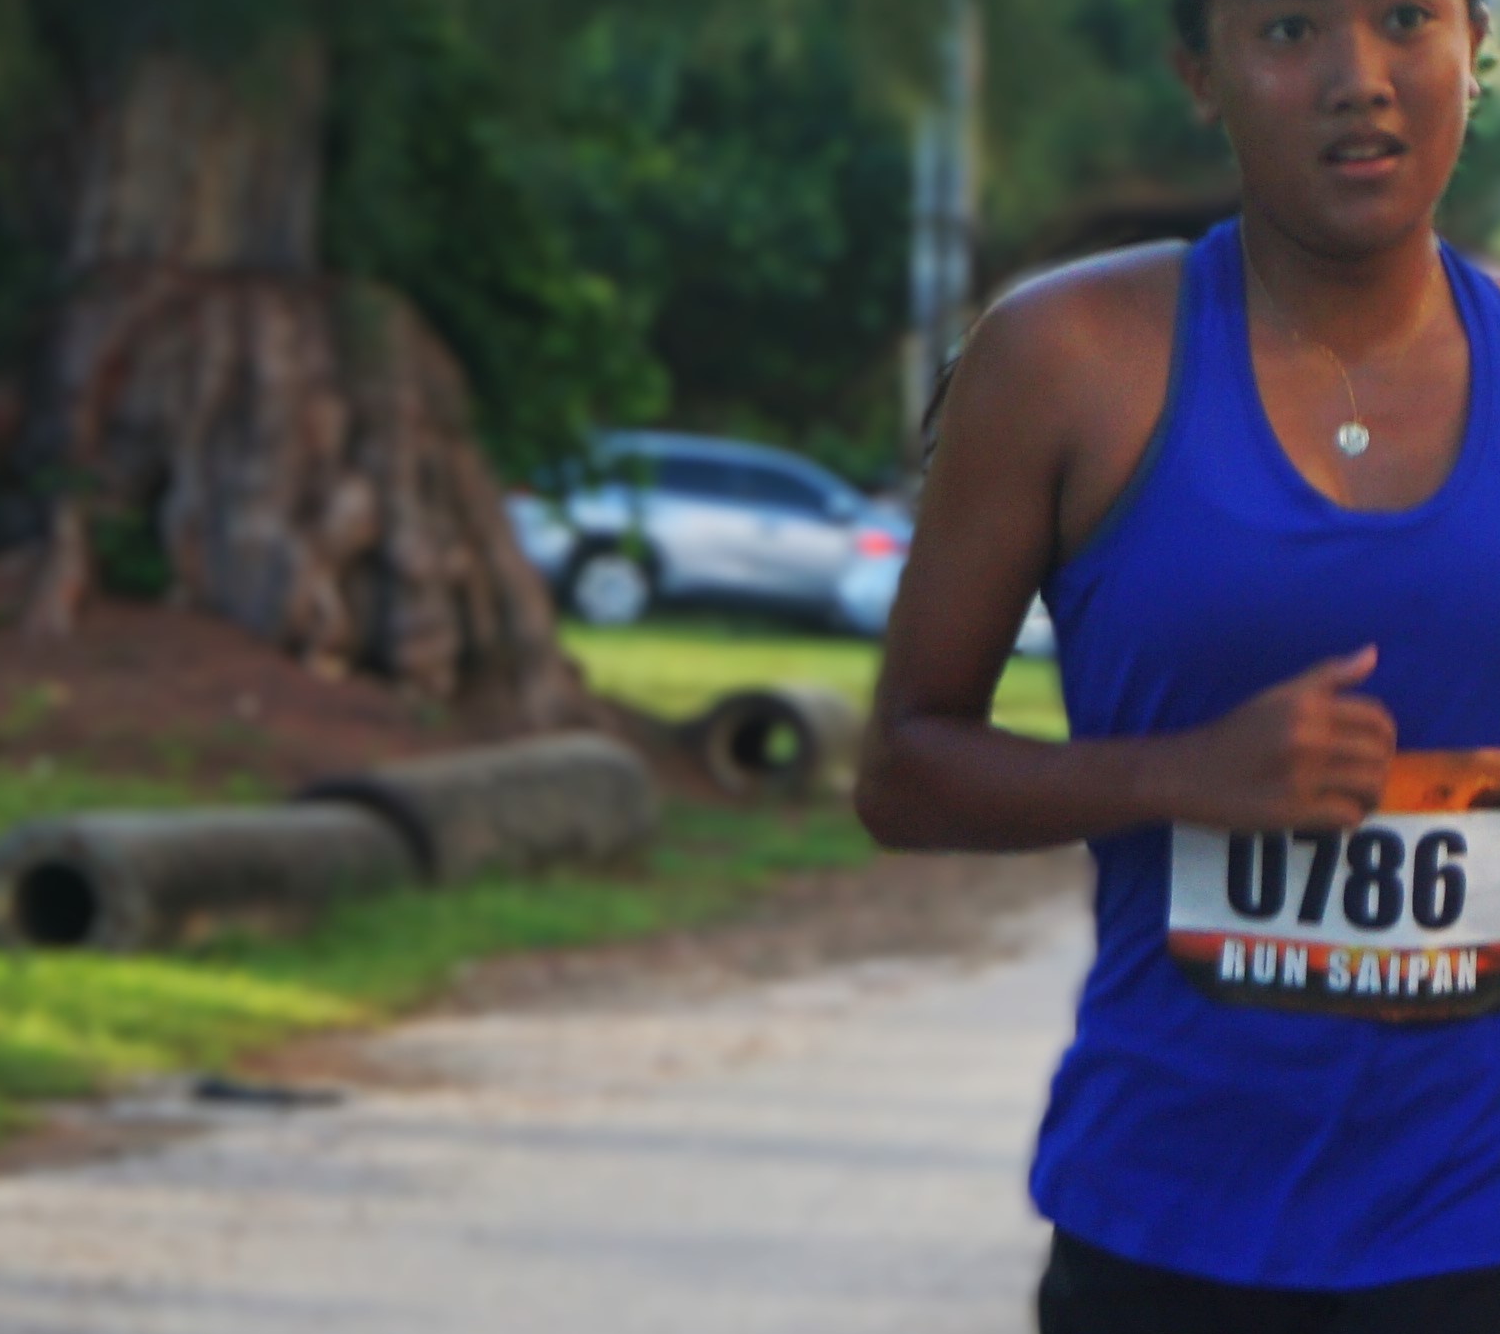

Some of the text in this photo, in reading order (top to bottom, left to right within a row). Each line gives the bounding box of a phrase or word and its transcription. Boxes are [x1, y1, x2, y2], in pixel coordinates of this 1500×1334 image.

[1227, 827, 1468, 929] 0786
[1221, 938, 1478, 995] RUN SAIPAN
